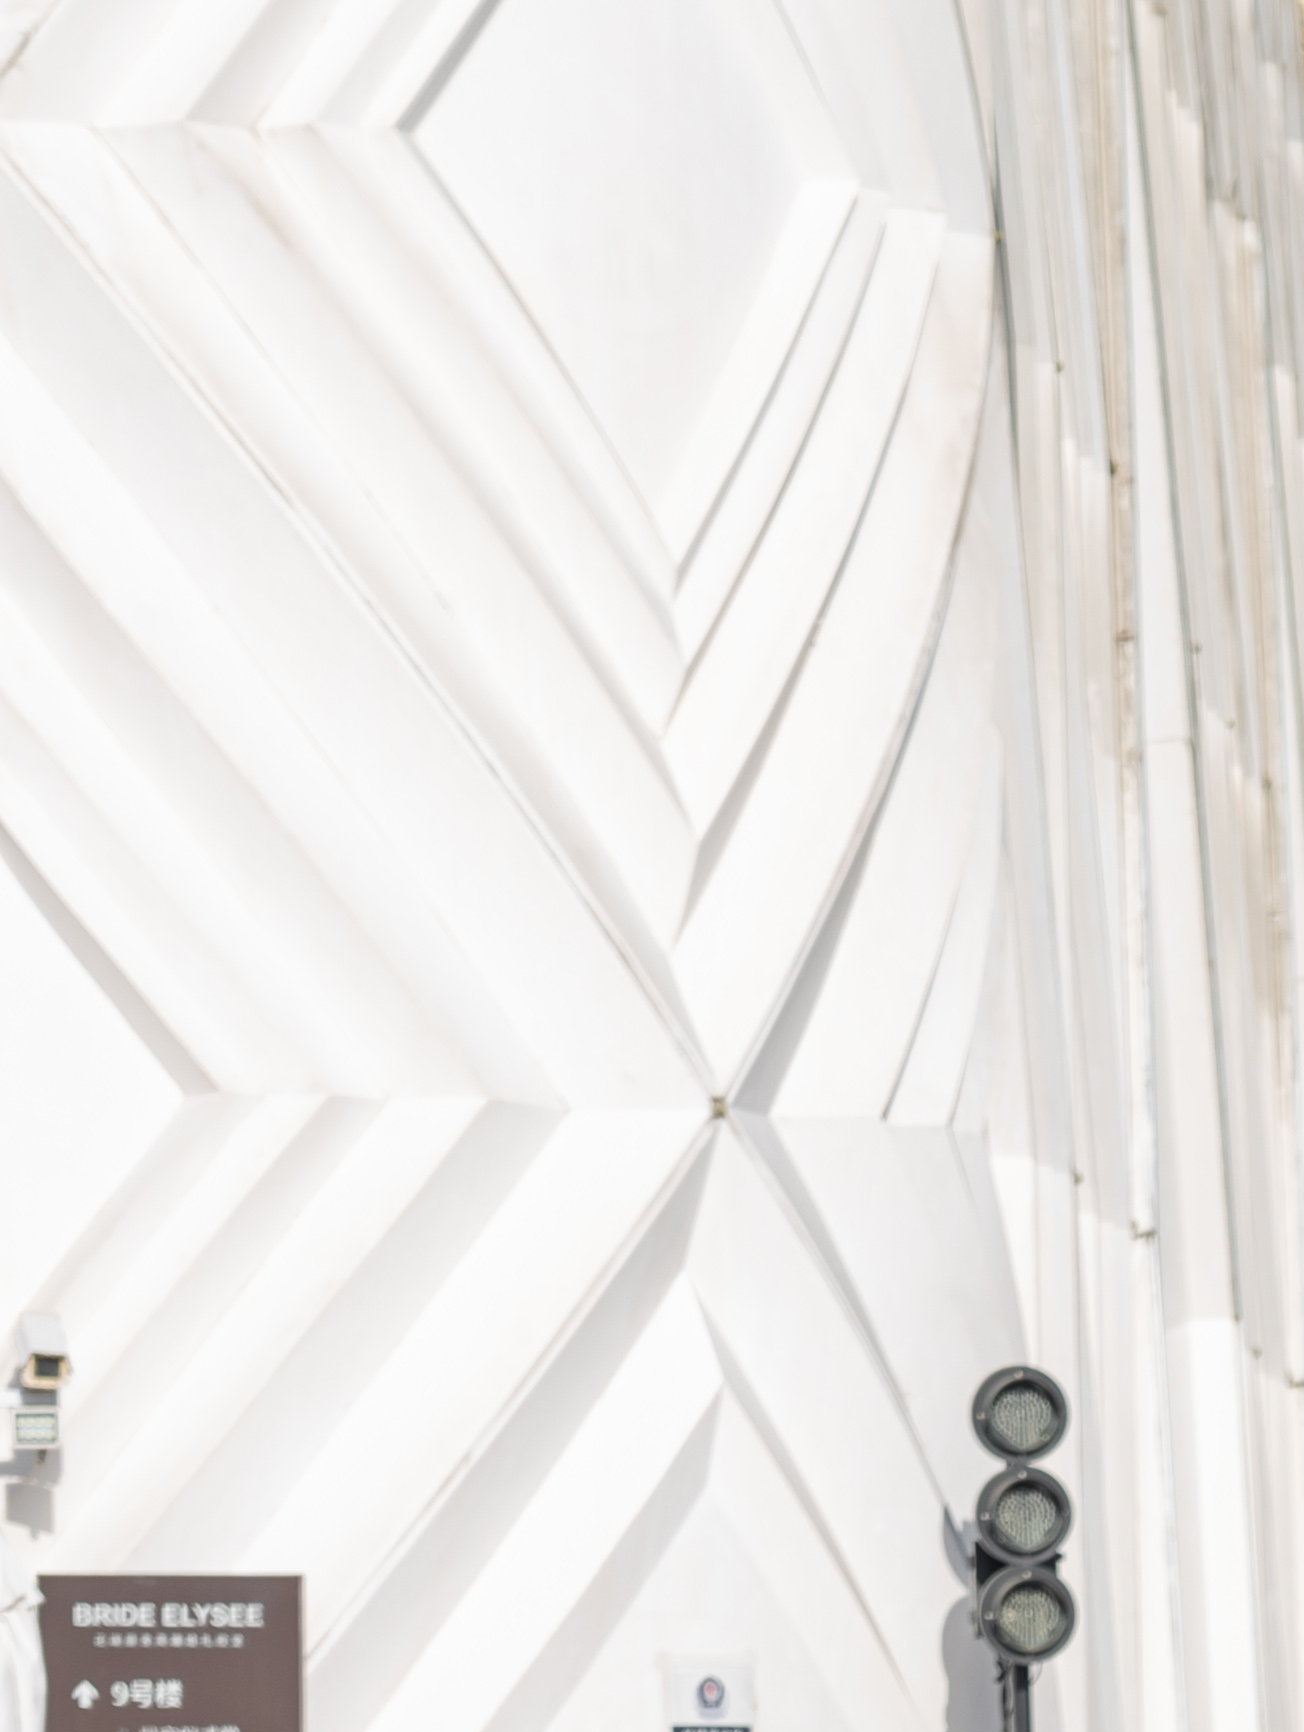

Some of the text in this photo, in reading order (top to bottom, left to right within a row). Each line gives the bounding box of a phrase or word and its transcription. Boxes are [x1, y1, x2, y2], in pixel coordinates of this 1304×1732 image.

[72, 1602, 265, 1627] BRIDE ELYSEE
[110, 1678, 183, 1709] 9号楼
